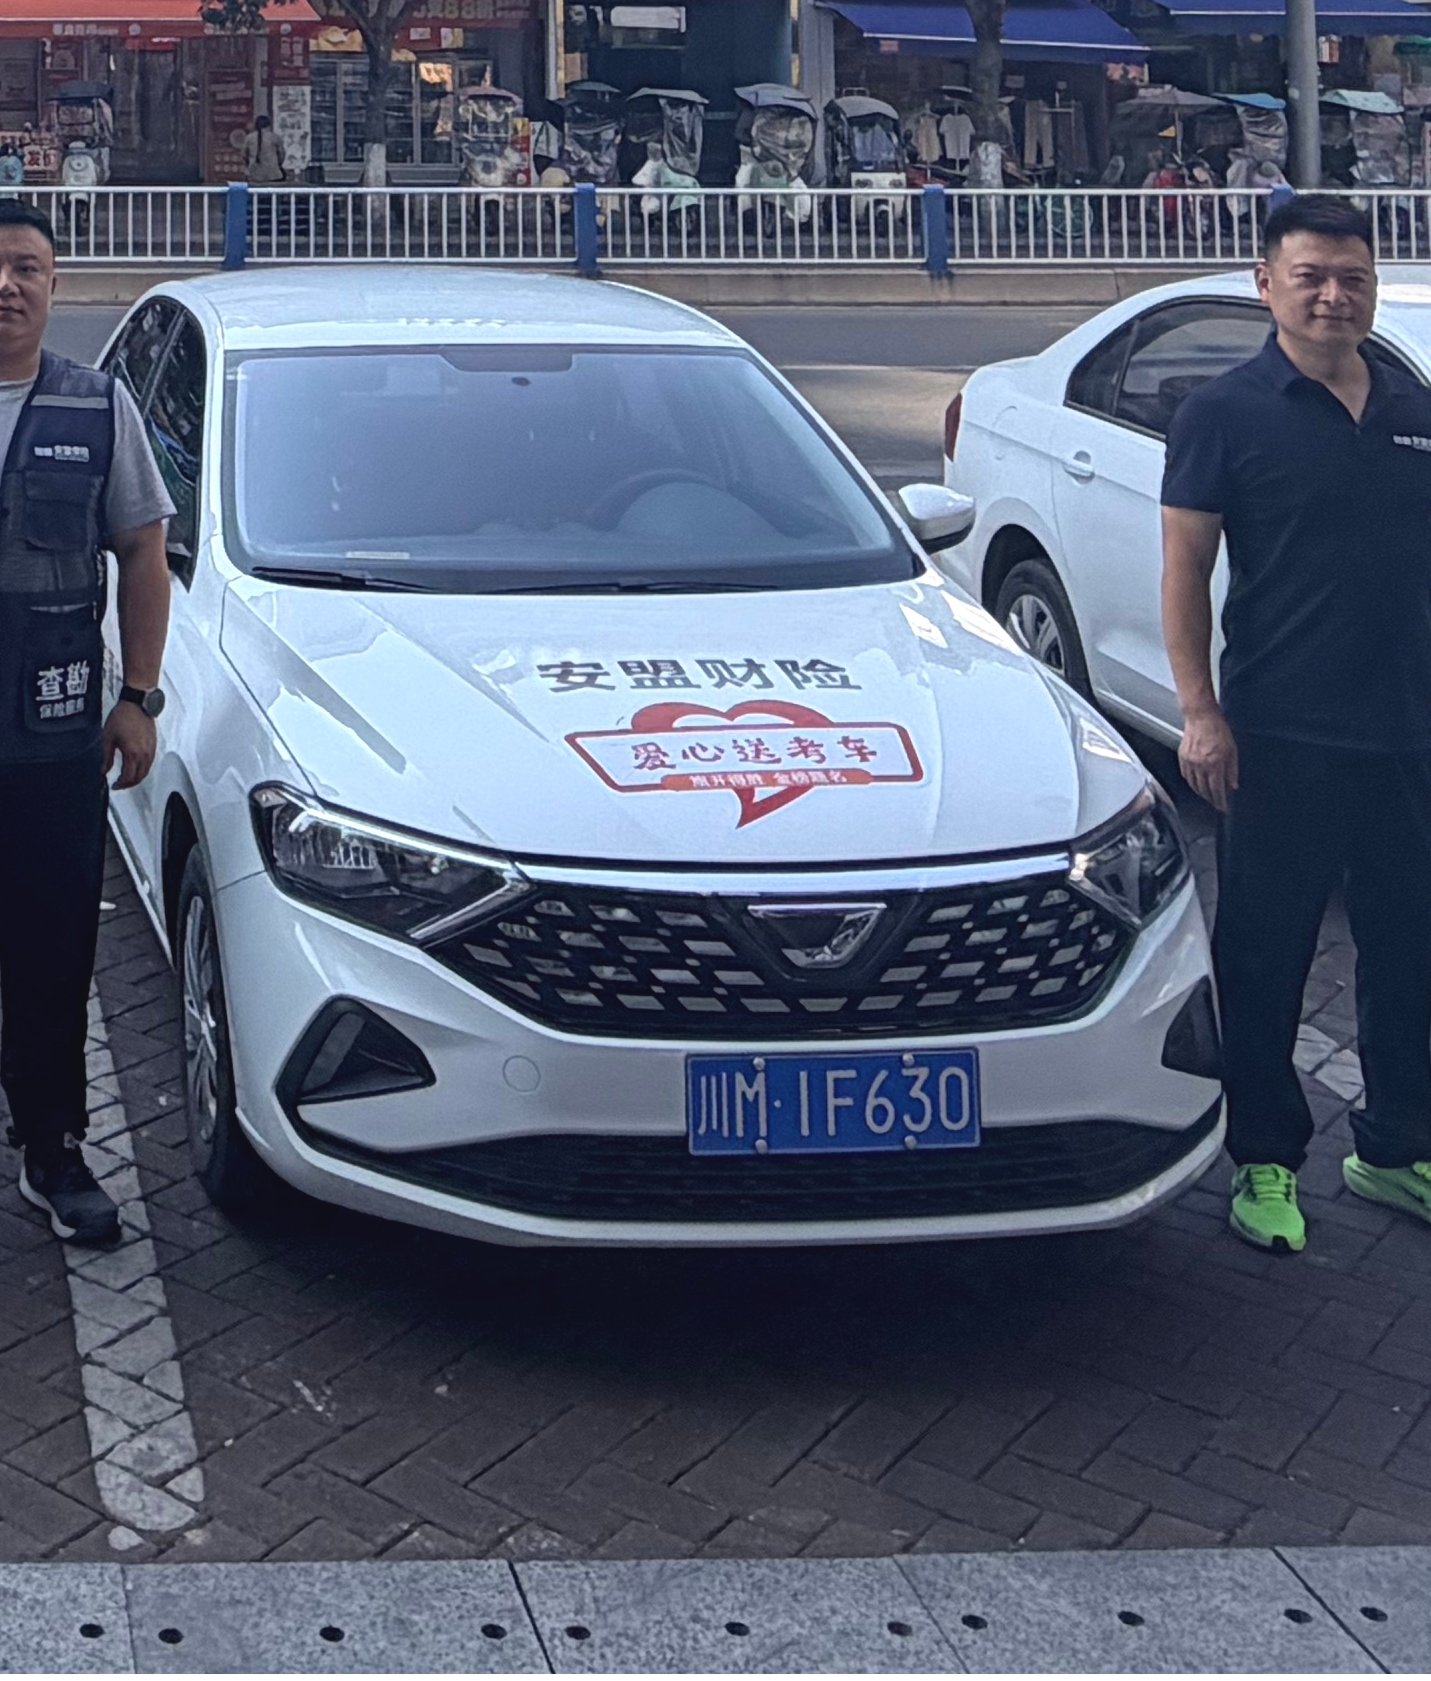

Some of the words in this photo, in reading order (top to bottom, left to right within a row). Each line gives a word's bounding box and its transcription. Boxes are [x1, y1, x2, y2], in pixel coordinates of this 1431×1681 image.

[35, 660, 90, 701] 查勘
[536, 658, 863, 693] 安盟财险
[630, 735, 878, 771] 爱心送考车
[772, 771, 848, 786] 金榜题名
